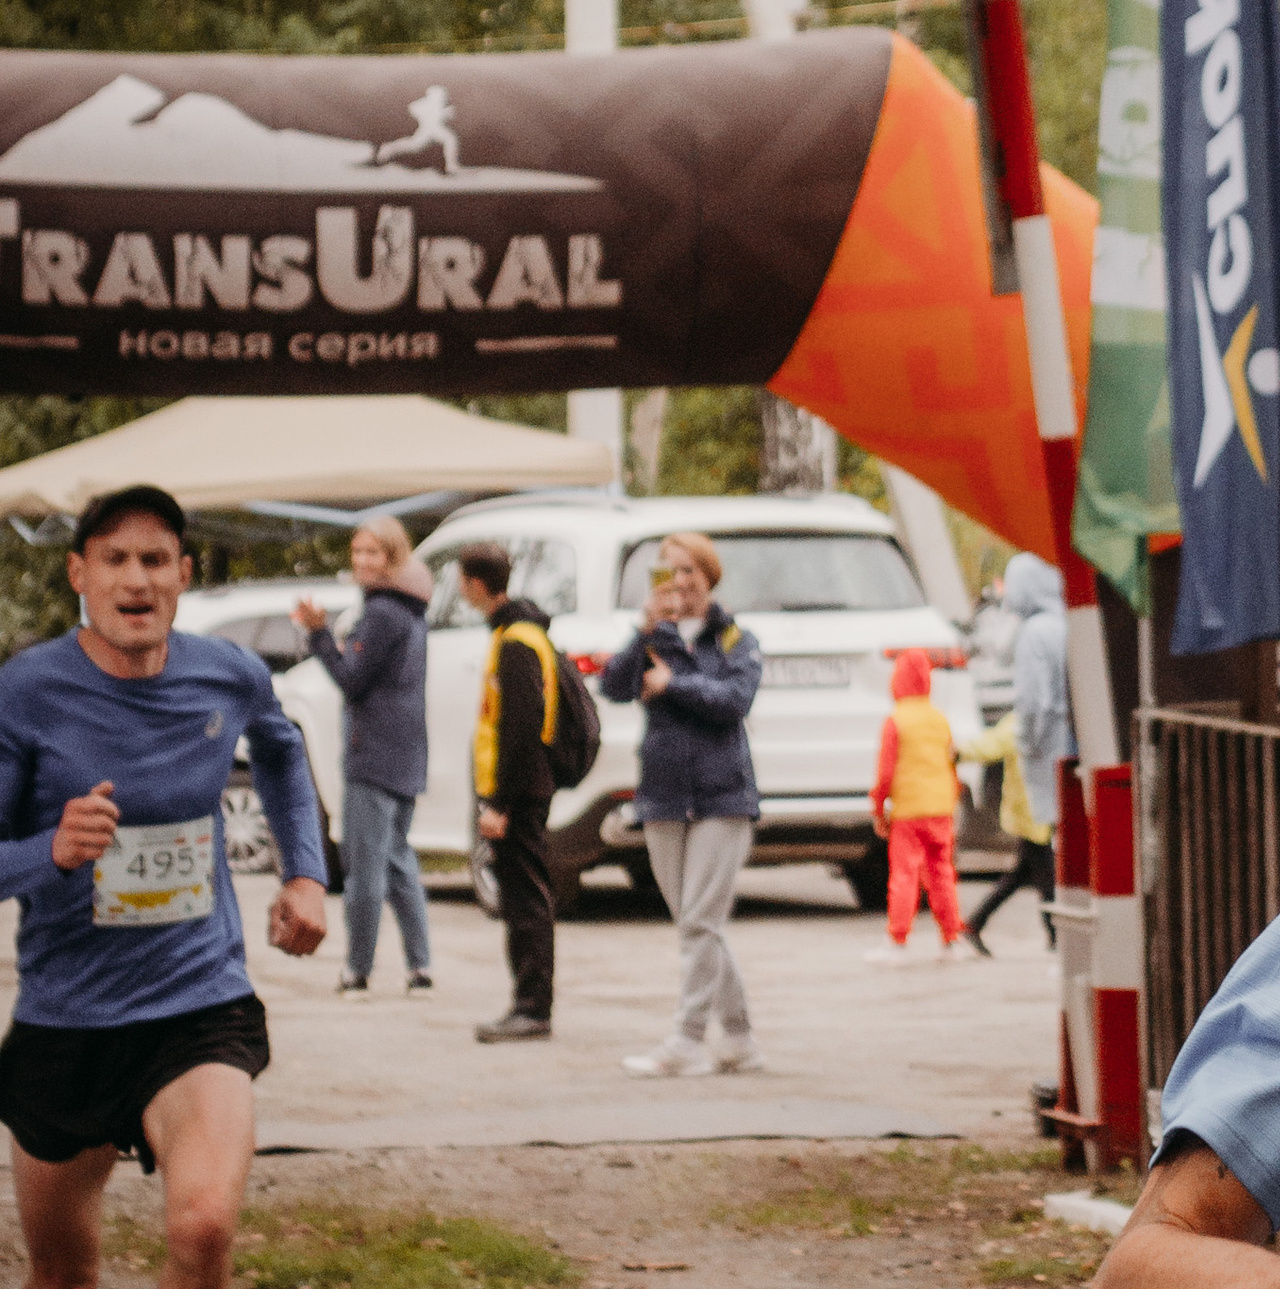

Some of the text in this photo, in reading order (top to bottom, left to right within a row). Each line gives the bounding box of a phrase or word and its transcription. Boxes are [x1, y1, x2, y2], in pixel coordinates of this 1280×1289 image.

[118, 329, 439, 368] новая серия
[126, 846, 195, 879] 495
